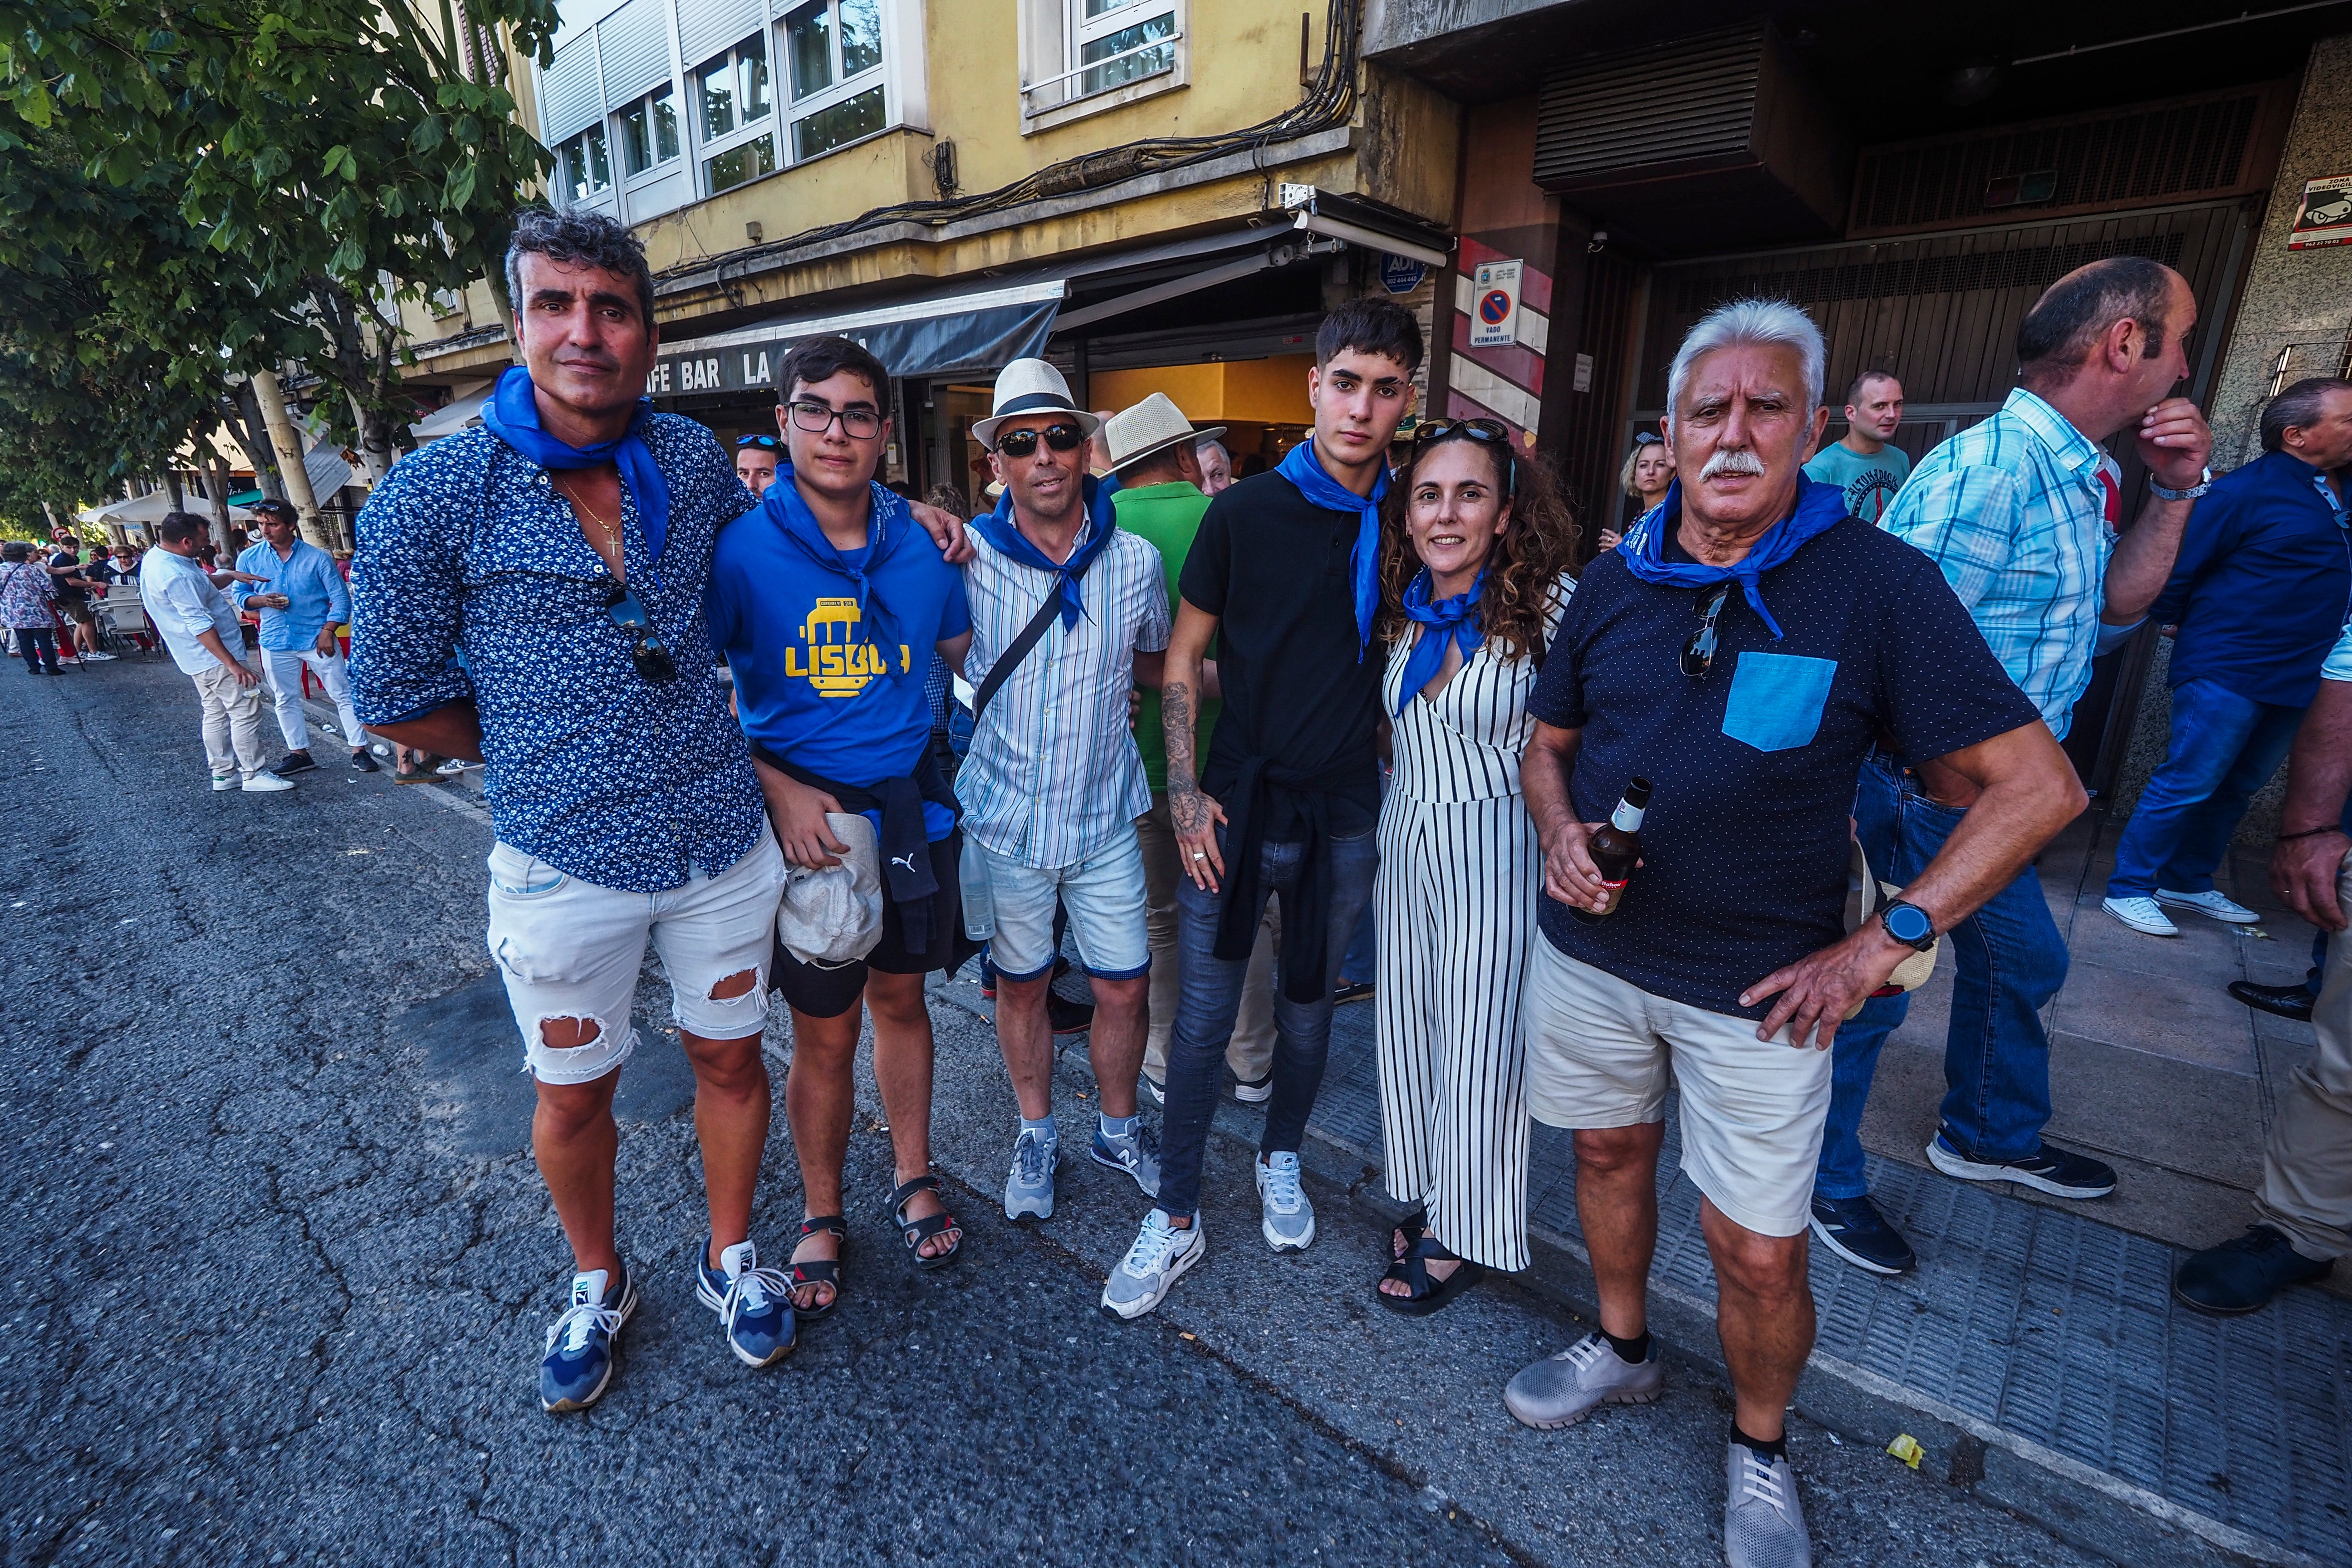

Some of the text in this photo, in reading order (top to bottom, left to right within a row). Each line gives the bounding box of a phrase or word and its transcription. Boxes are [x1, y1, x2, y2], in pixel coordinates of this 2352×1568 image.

[1475, 335, 1511, 343] PERMANENTE
[681, 358, 720, 390] BAR
[743, 352, 771, 385] LA
